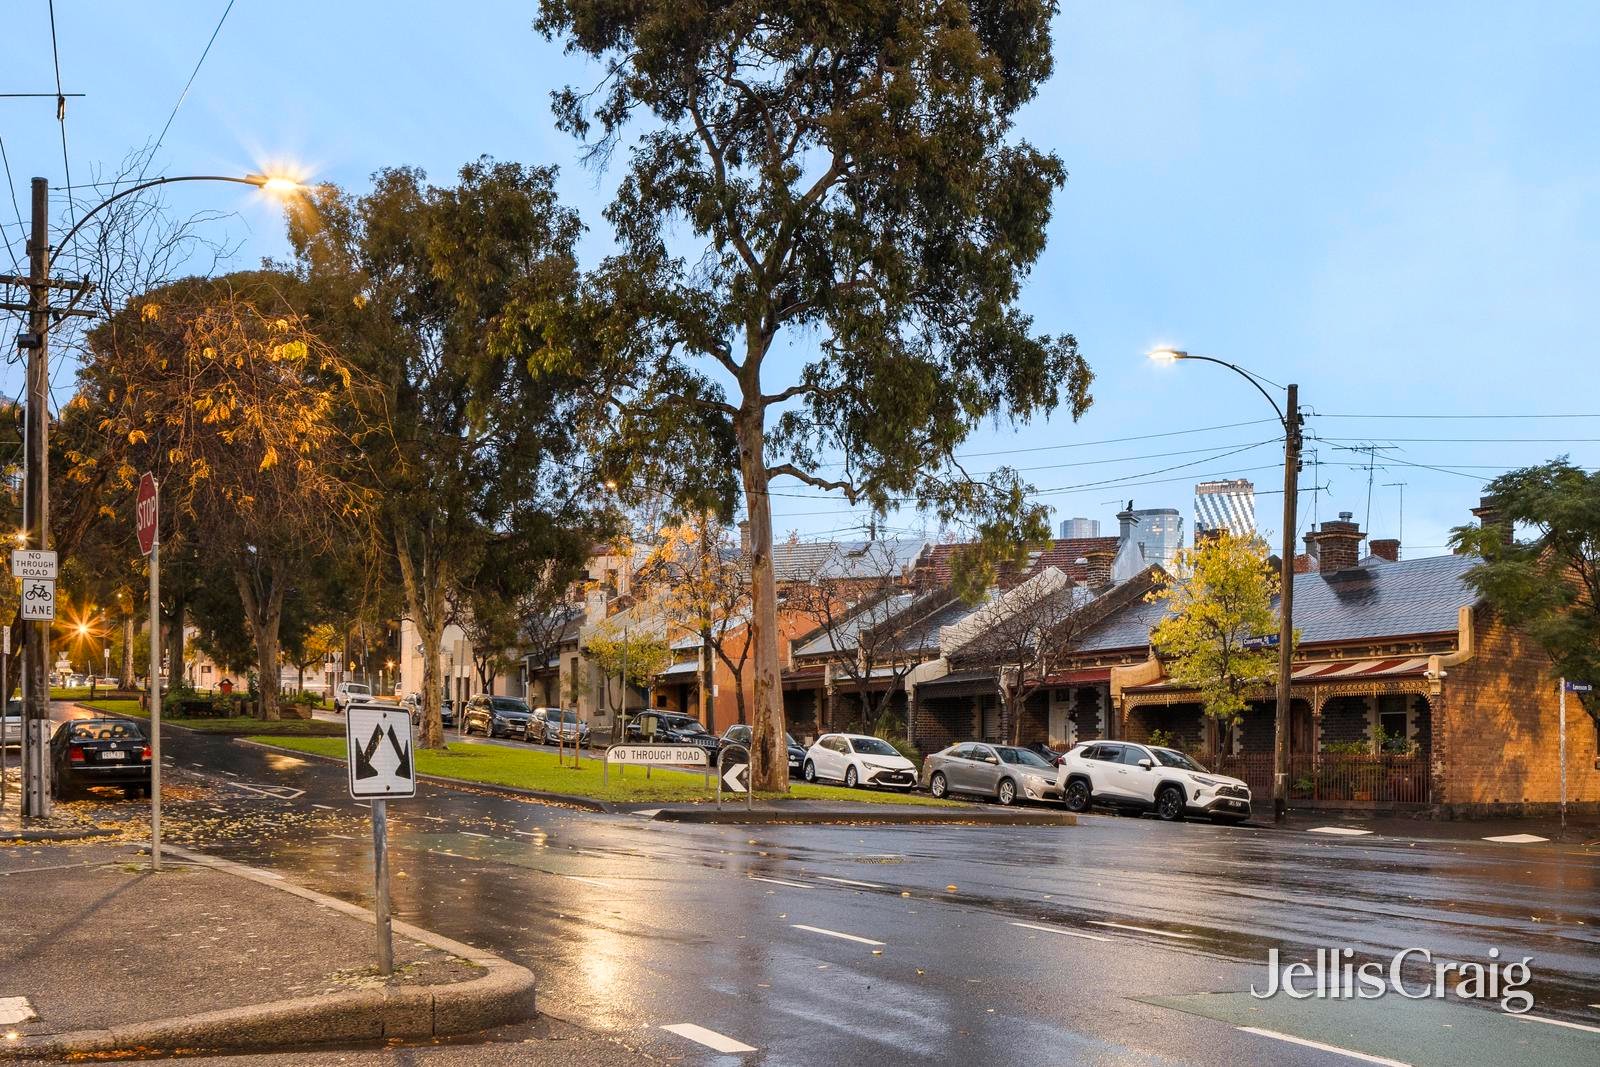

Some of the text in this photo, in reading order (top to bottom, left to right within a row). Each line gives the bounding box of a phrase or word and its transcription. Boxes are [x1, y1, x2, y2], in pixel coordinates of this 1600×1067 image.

[138, 496, 156, 531] STOP
[28, 552, 41, 560] NO
[15, 560, 54, 568] THROUGH
[22, 568, 48, 576] ROAD
[25, 604, 52, 615] LANE
[614, 749, 700, 761] NO THROUGH ROAD
